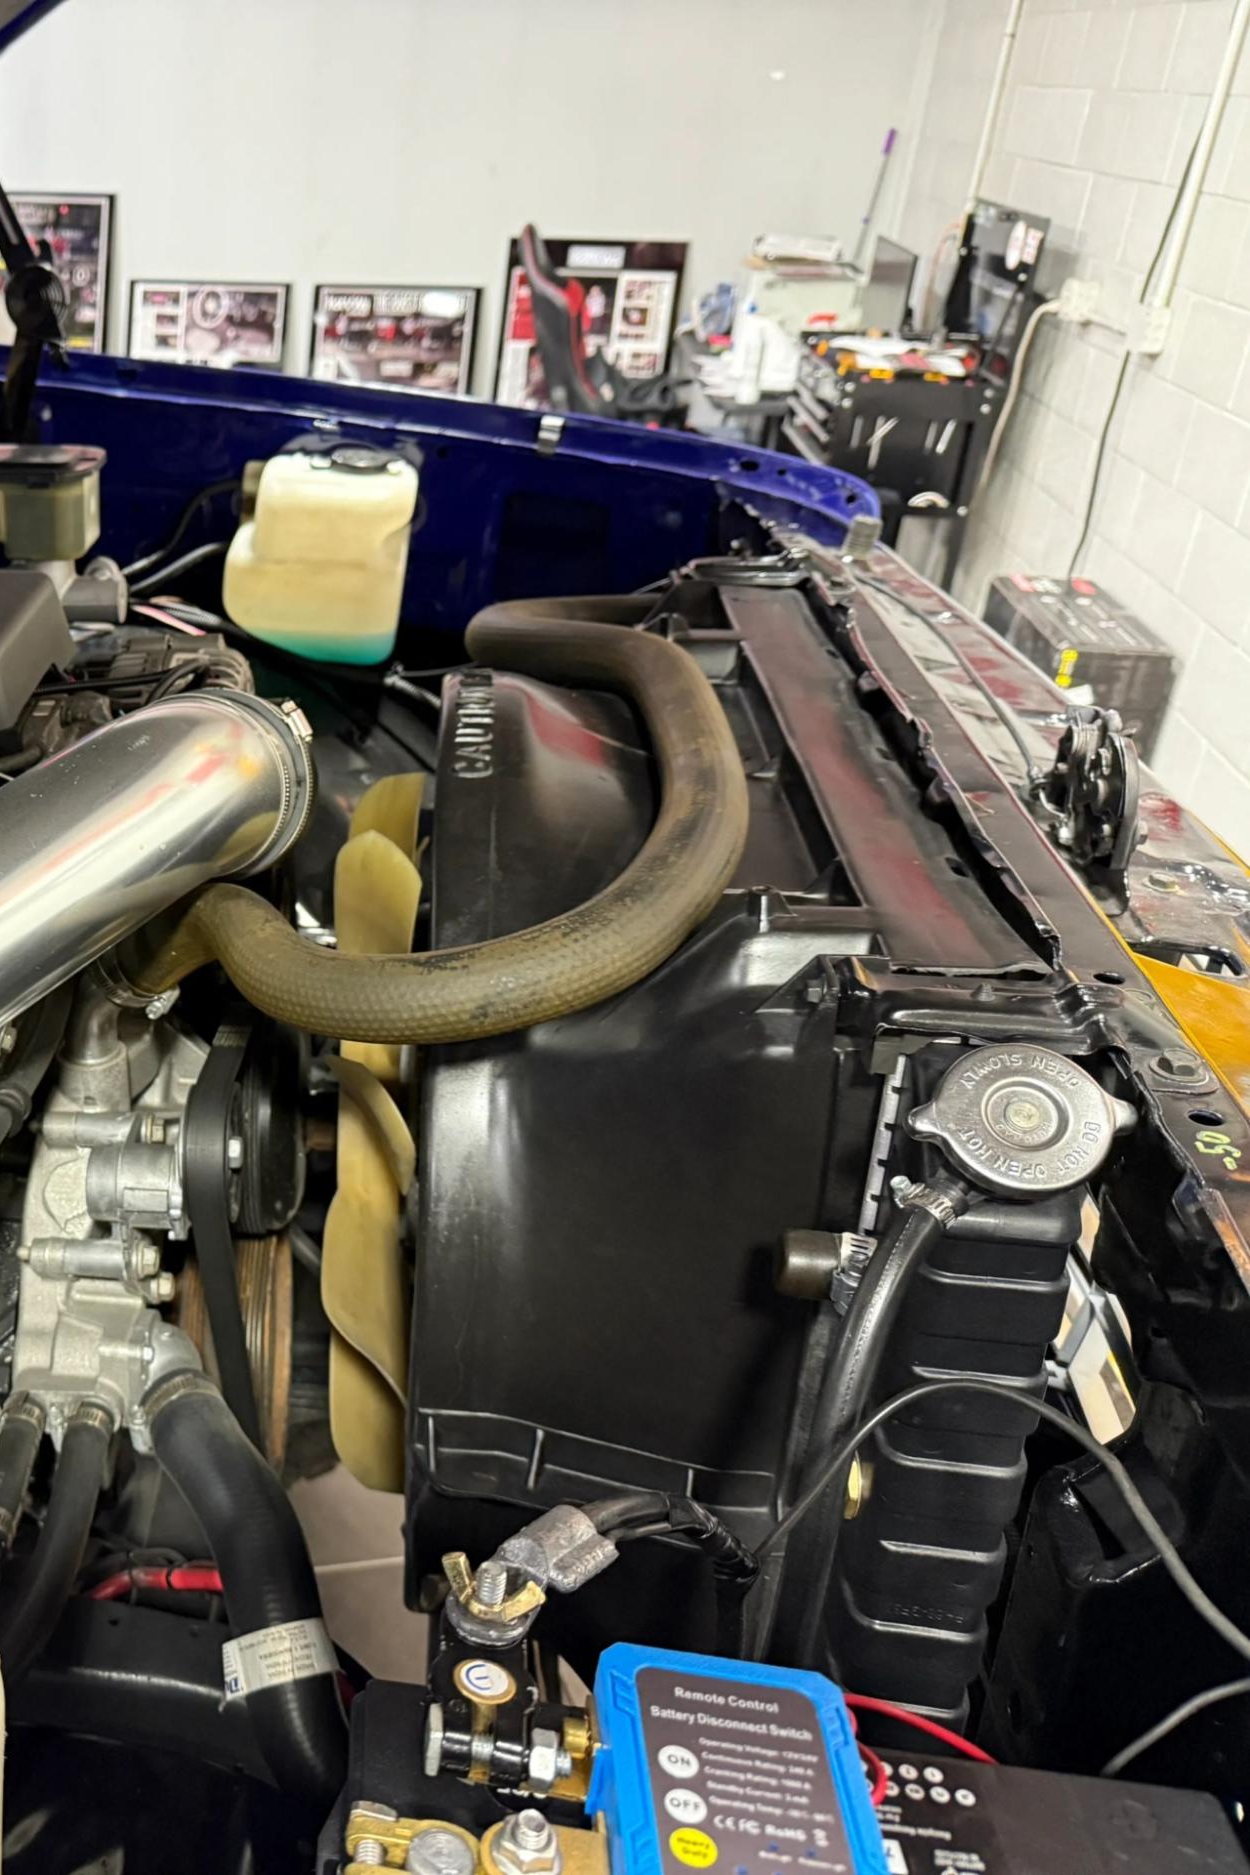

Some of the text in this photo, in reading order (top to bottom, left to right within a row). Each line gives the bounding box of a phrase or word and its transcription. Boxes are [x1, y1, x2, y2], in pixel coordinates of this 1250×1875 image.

[959, 1053, 1080, 1090] OPEN SLOWLY
[958, 1127, 993, 1160] HOT
[994, 1155, 1048, 1178] OPEN
[1056, 1145, 1087, 1176] NOT
[674, 1686, 779, 1714] Remote Control
[650, 1705, 813, 1742] Battery Disconnect Switch
[666, 1753, 692, 1768] ON
[669, 1796, 701, 1813] OFF
